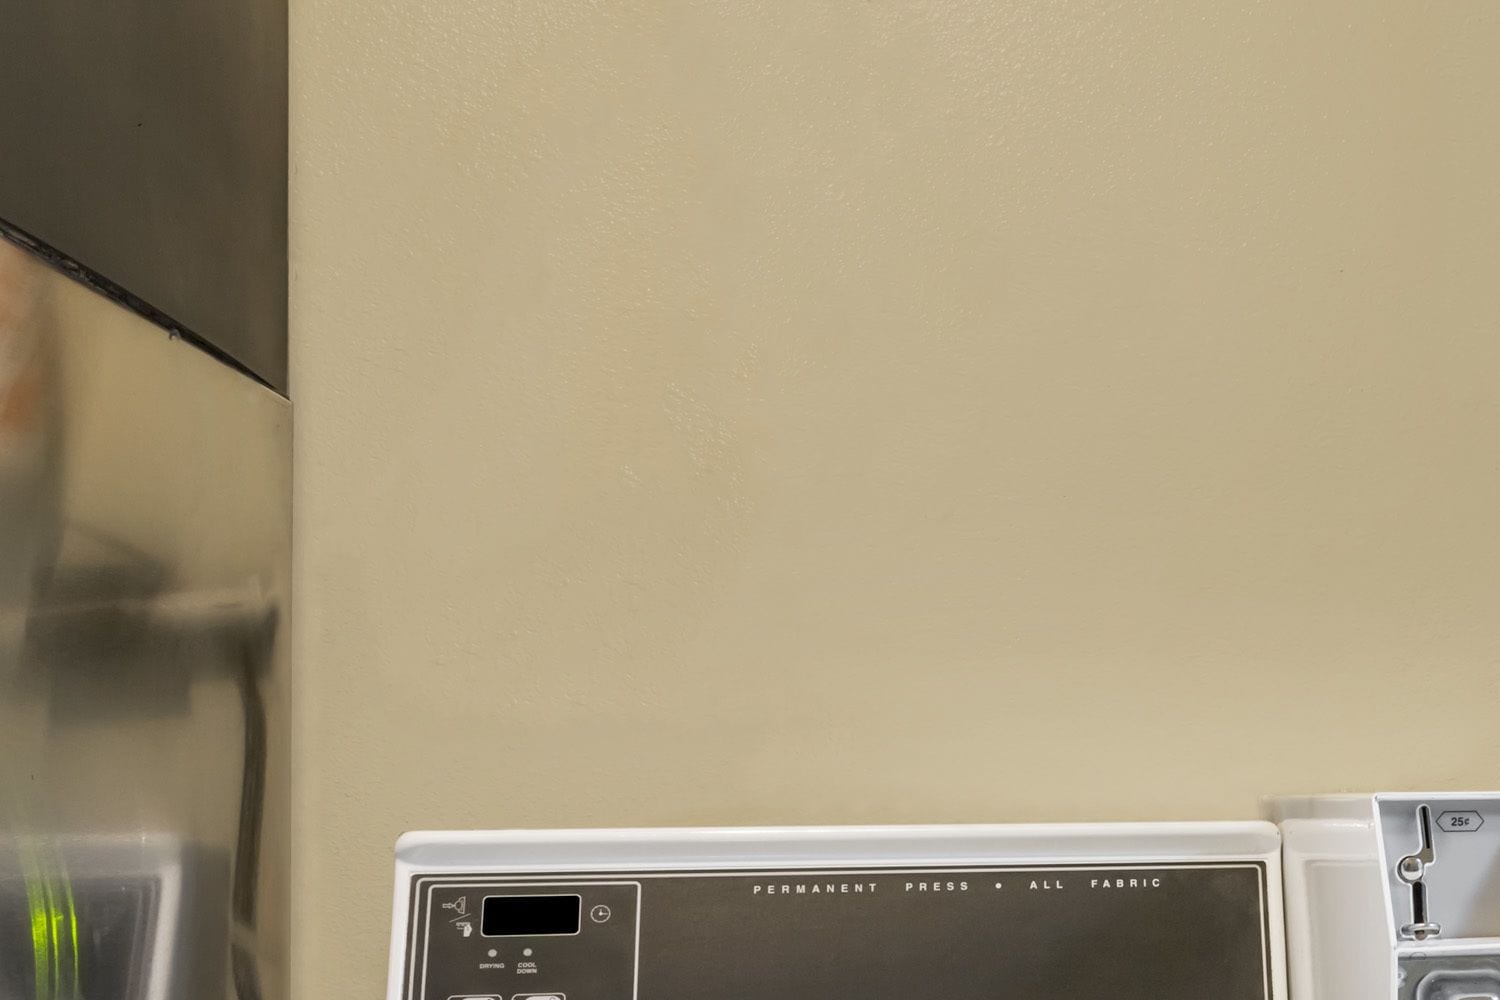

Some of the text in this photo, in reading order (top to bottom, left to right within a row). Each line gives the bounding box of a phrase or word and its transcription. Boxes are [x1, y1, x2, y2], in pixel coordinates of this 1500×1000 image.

[1451, 817, 1470, 826] 25¢
[752, 878, 1161, 895] PERMANENT PRESS ALL FABRIC
